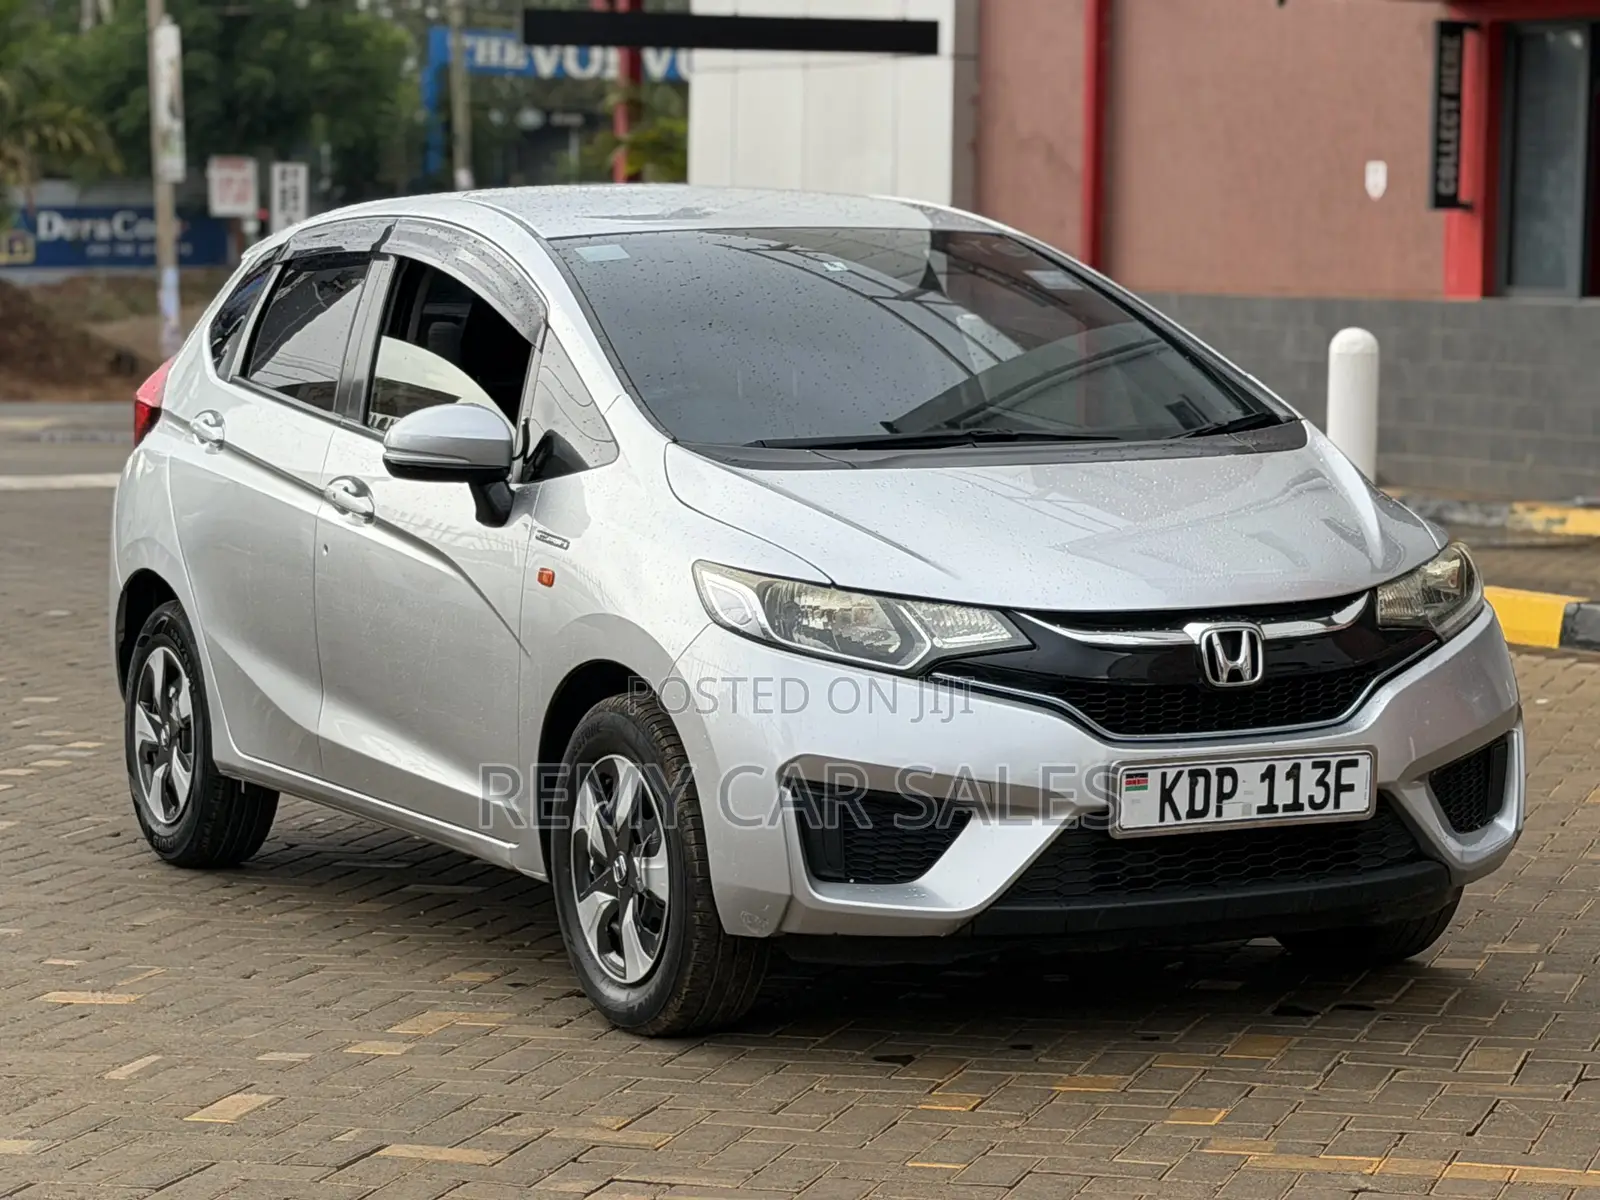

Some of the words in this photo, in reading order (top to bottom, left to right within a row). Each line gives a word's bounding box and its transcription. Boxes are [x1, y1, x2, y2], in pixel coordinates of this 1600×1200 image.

[531, 45, 693, 80] VOV
[1436, 97, 1460, 196] COLLECT
[1158, 766, 1239, 823] KDP
[1256, 759, 1359, 815] 113F
